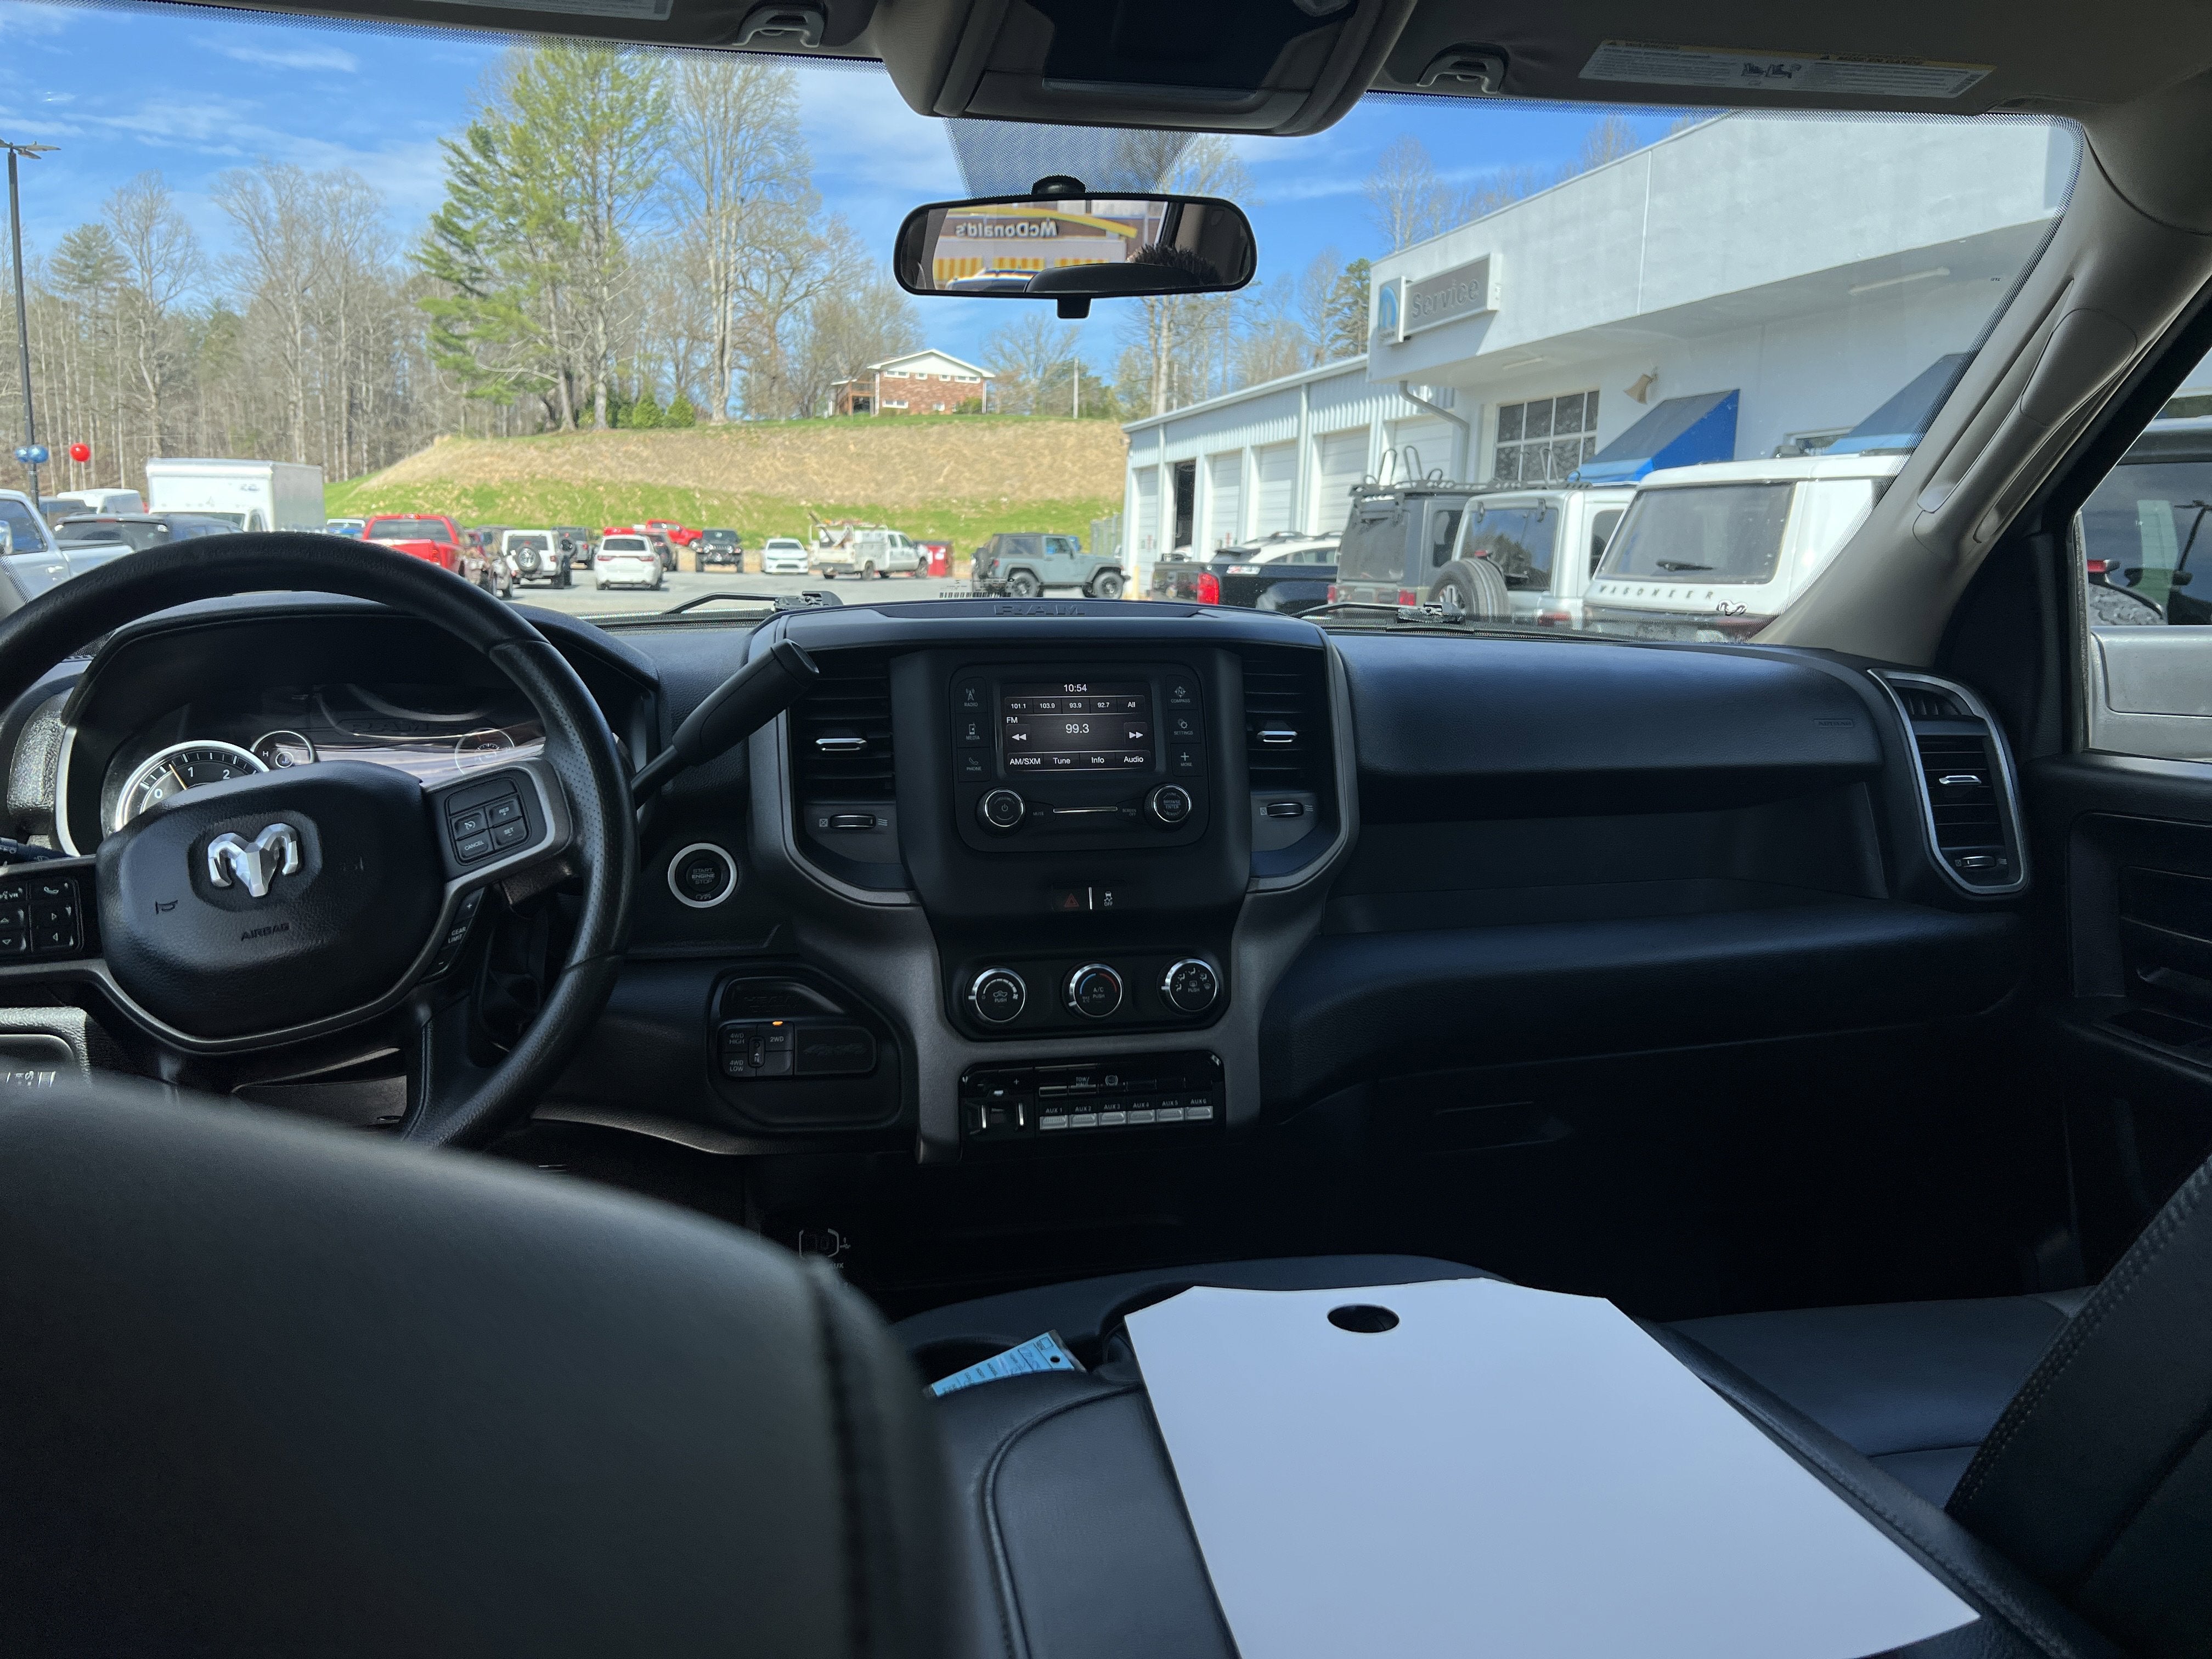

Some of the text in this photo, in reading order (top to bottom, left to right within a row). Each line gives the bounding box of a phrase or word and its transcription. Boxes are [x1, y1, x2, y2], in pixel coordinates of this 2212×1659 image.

[1412, 279, 1480, 320] Service
[994, 605, 1085, 615] RAM
[1064, 684, 1087, 692] 10:54
[1065, 723, 1090, 733] 99.3
[188, 766, 194, 777] 1
[223, 769, 230, 780] 2
[154, 788, 163, 799] 0
[465, 840, 484, 851] CANCEL
[241, 923, 290, 941] AIRBAG
[452, 926, 466, 936] GEAR
[448, 934, 463, 944] LIMIT
